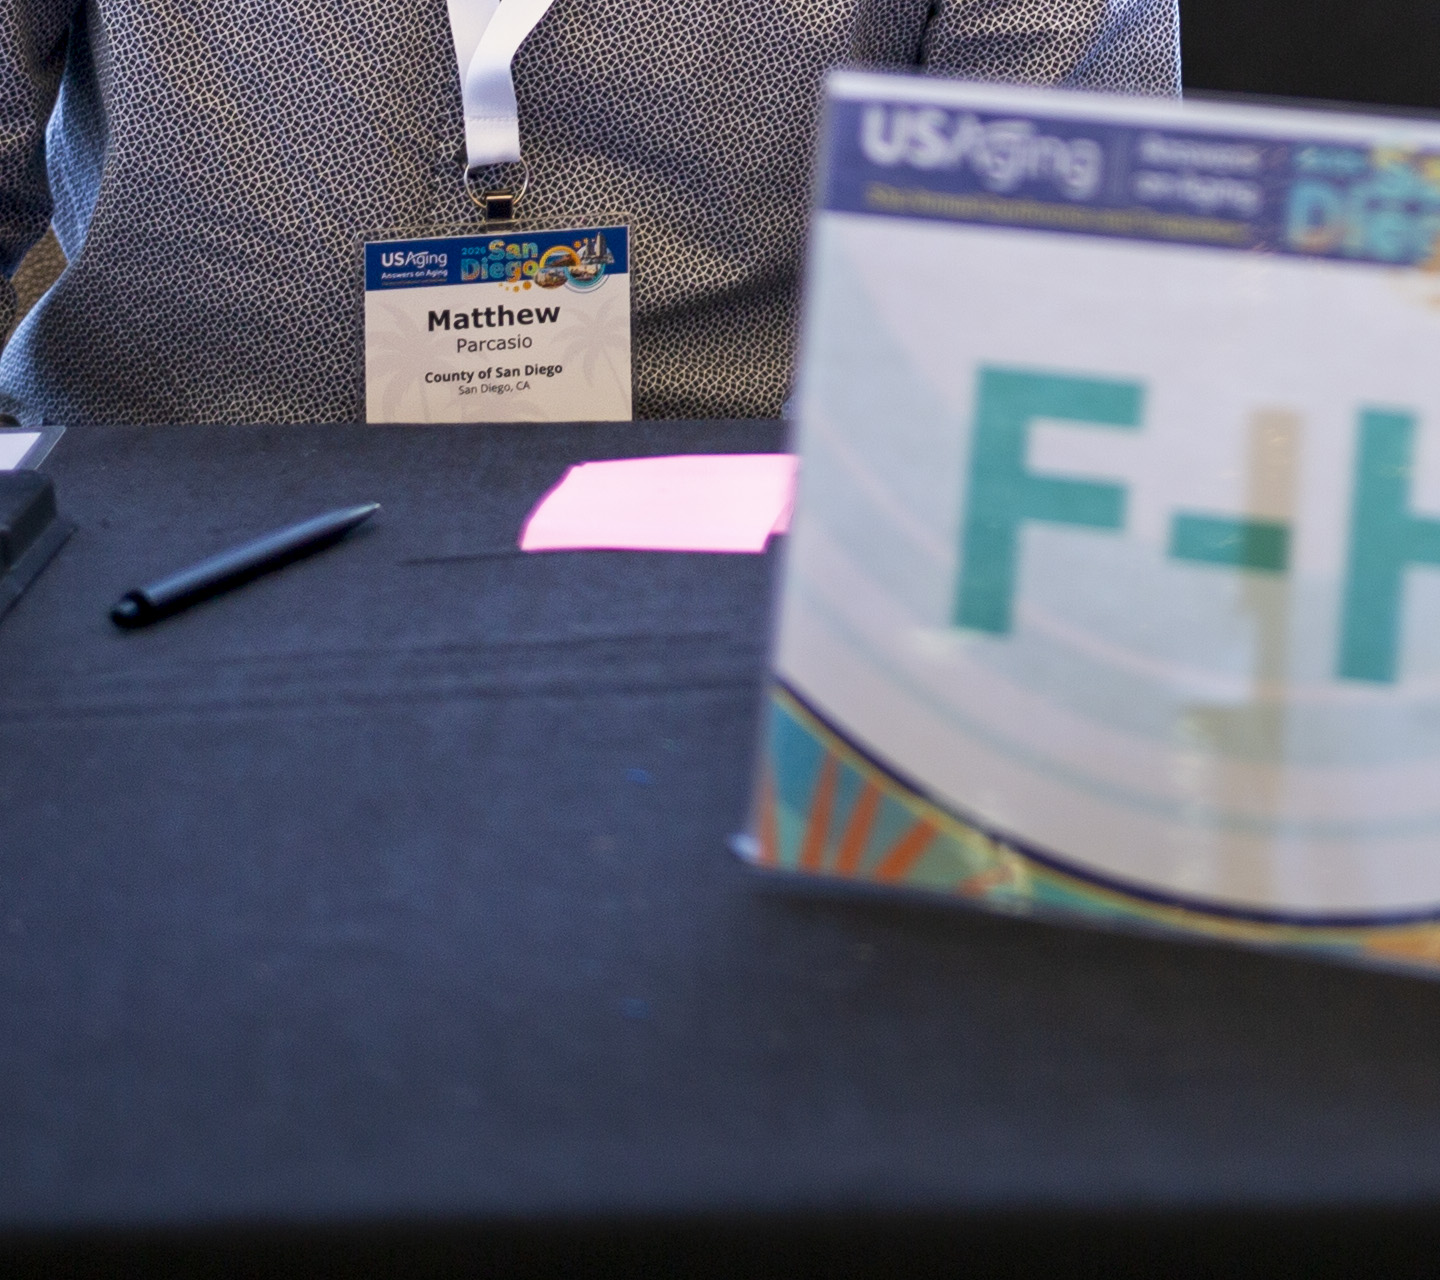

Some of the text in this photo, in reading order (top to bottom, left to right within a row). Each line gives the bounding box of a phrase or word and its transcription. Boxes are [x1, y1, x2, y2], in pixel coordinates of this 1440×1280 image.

[488, 239, 538, 260] San
[381, 251, 448, 269] USAging
[461, 257, 539, 283] Diego
[381, 271, 414, 280] Answers
[426, 268, 448, 278] Aging
[428, 304, 561, 332] Matthew
[456, 334, 533, 354] Parcasio
[425, 362, 563, 384] County of San Diego
[458, 380, 531, 396] San Diego, CA
